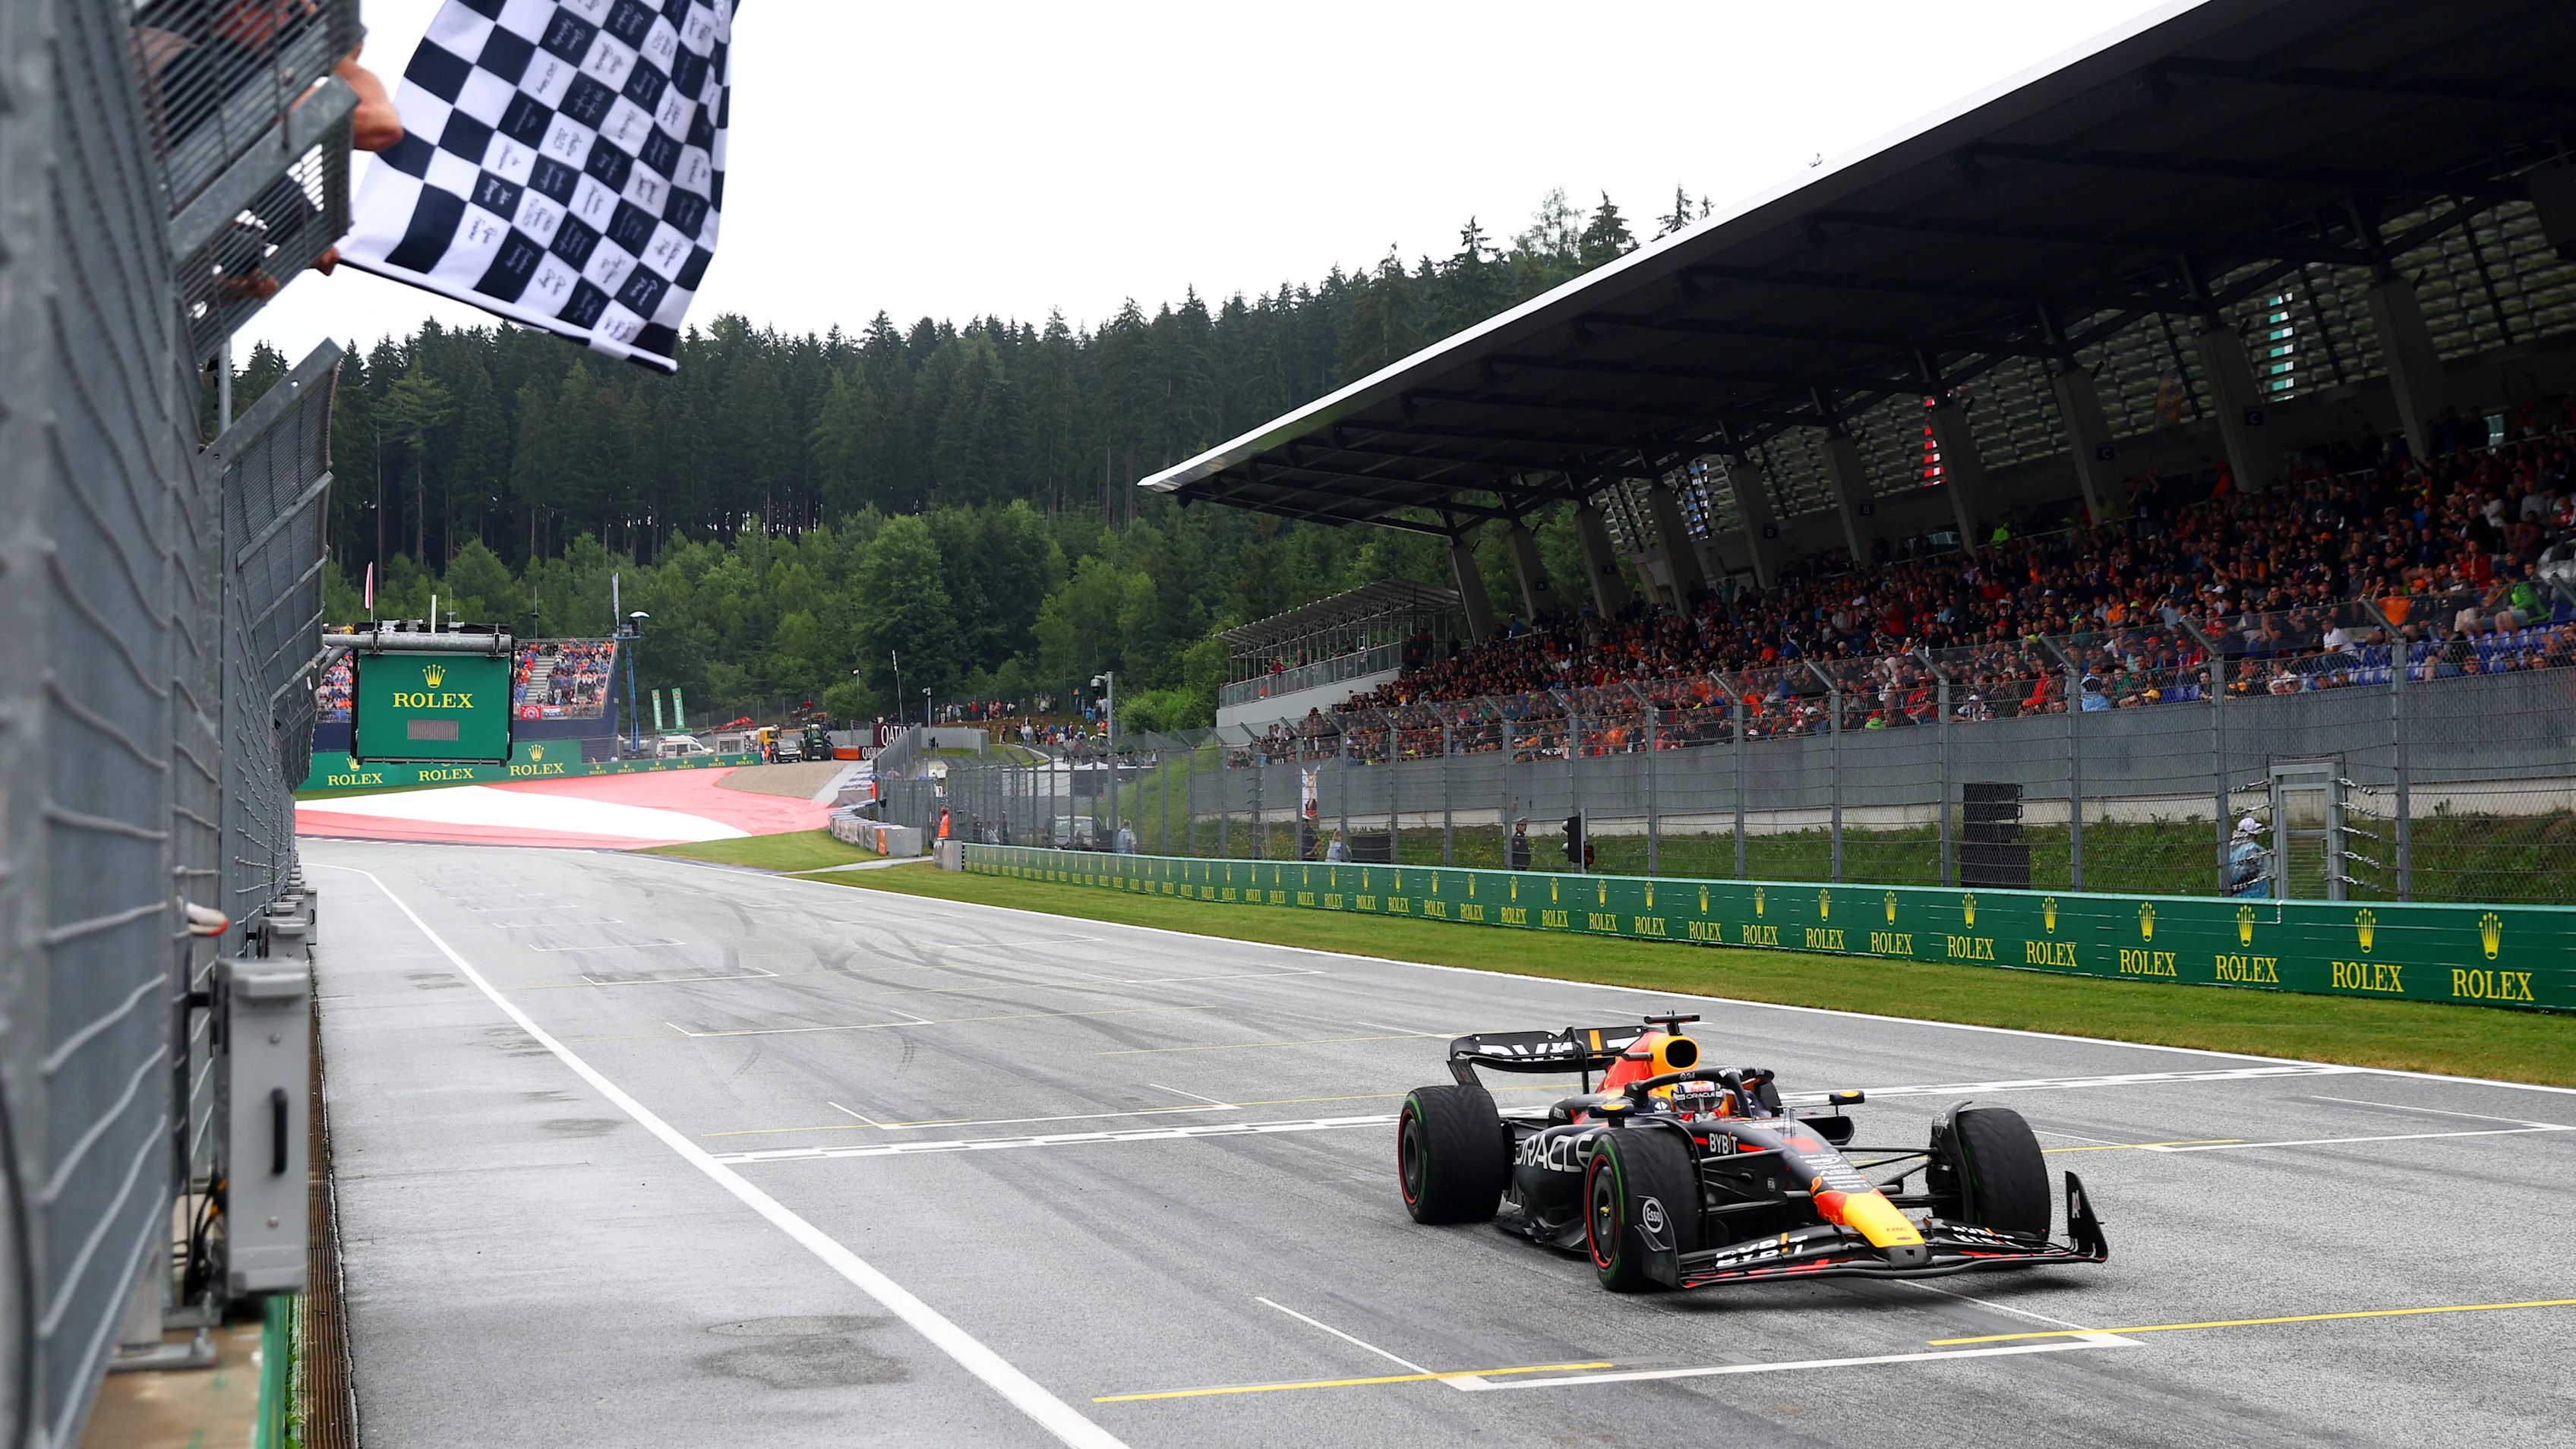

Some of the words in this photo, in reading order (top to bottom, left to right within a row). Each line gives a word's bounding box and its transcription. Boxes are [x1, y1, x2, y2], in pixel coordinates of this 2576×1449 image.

[393, 692, 474, 709] ROLEX
[419, 768, 474, 781] ROLEX
[510, 762, 564, 776] ROLEX
[327, 773, 383, 786] ROLEX
[1270, 890, 1286, 904] ROLEX
[1297, 892, 1315, 906] ROLEX
[1324, 893, 1343, 908] ROLEX
[1356, 895, 1376, 911] ROLEX
[1388, 897, 1410, 913] ROLEX
[1425, 899, 1447, 917] ROLEX
[1460, 903, 1483, 920] ROLEX
[1501, 907, 1526, 924] ROLEX
[1542, 910, 1569, 927] ROLEX
[1589, 912, 1618, 932] ROLEX
[1635, 916, 1665, 936] ROLEX
[1688, 920, 1722, 941] ROLEX
[1742, 924, 1779, 945] ROLEX
[1806, 927, 1845, 950] ROLEX
[1870, 932, 1913, 955] ROLEX
[1947, 935, 1995, 961] ROLEX
[2025, 941, 2077, 967] ROLEX
[2120, 949, 2177, 977] ROLEX
[2215, 955, 2279, 983] ROLEX
[2331, 961, 2404, 993] ROLEX
[2451, 968, 2535, 1001] ROLEX
[1709, 1132, 1738, 1155] BYBIT
[1646, 1207, 1661, 1223] Esso
